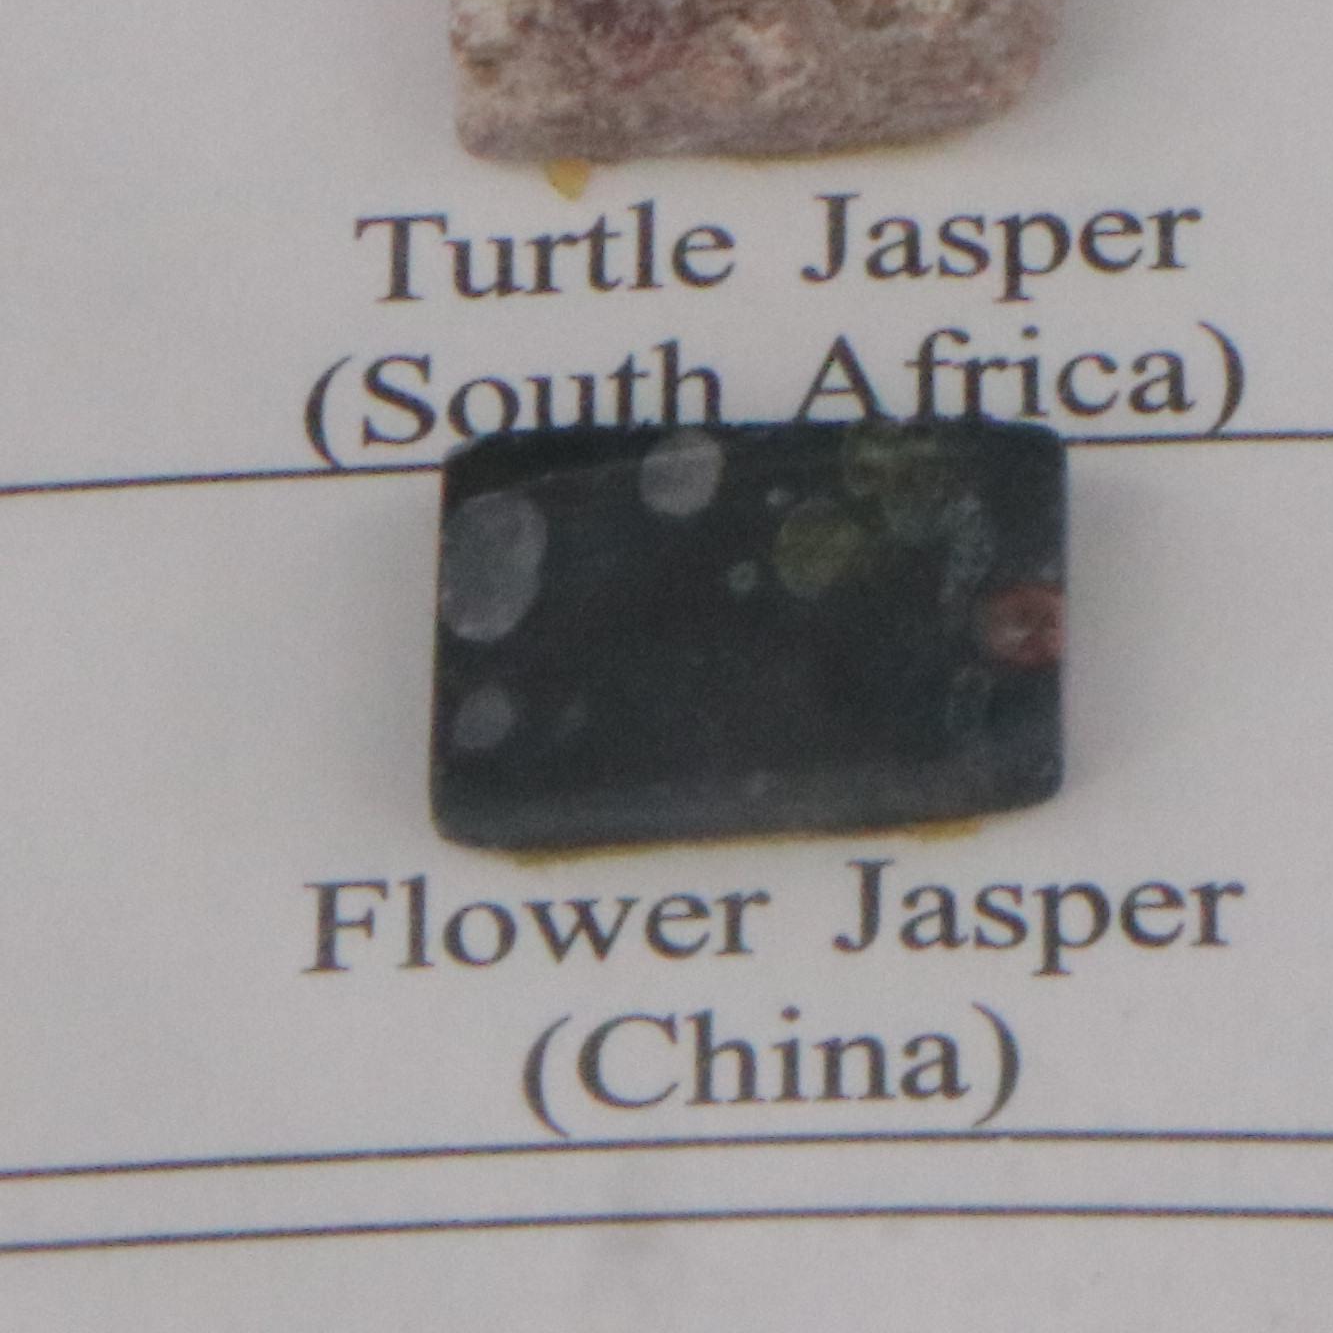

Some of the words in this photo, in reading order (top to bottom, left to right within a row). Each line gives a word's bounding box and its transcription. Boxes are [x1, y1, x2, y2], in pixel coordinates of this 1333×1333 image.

[353, 198, 736, 304] Turtle
[800, 193, 1204, 304] Jasper
[303, 338, 725, 469] (South
[796, 320, 1248, 434] Africa)
[301, 873, 771, 975] Flower
[832, 857, 1247, 978] Jasper
[520, 1001, 1022, 1138] (China)
